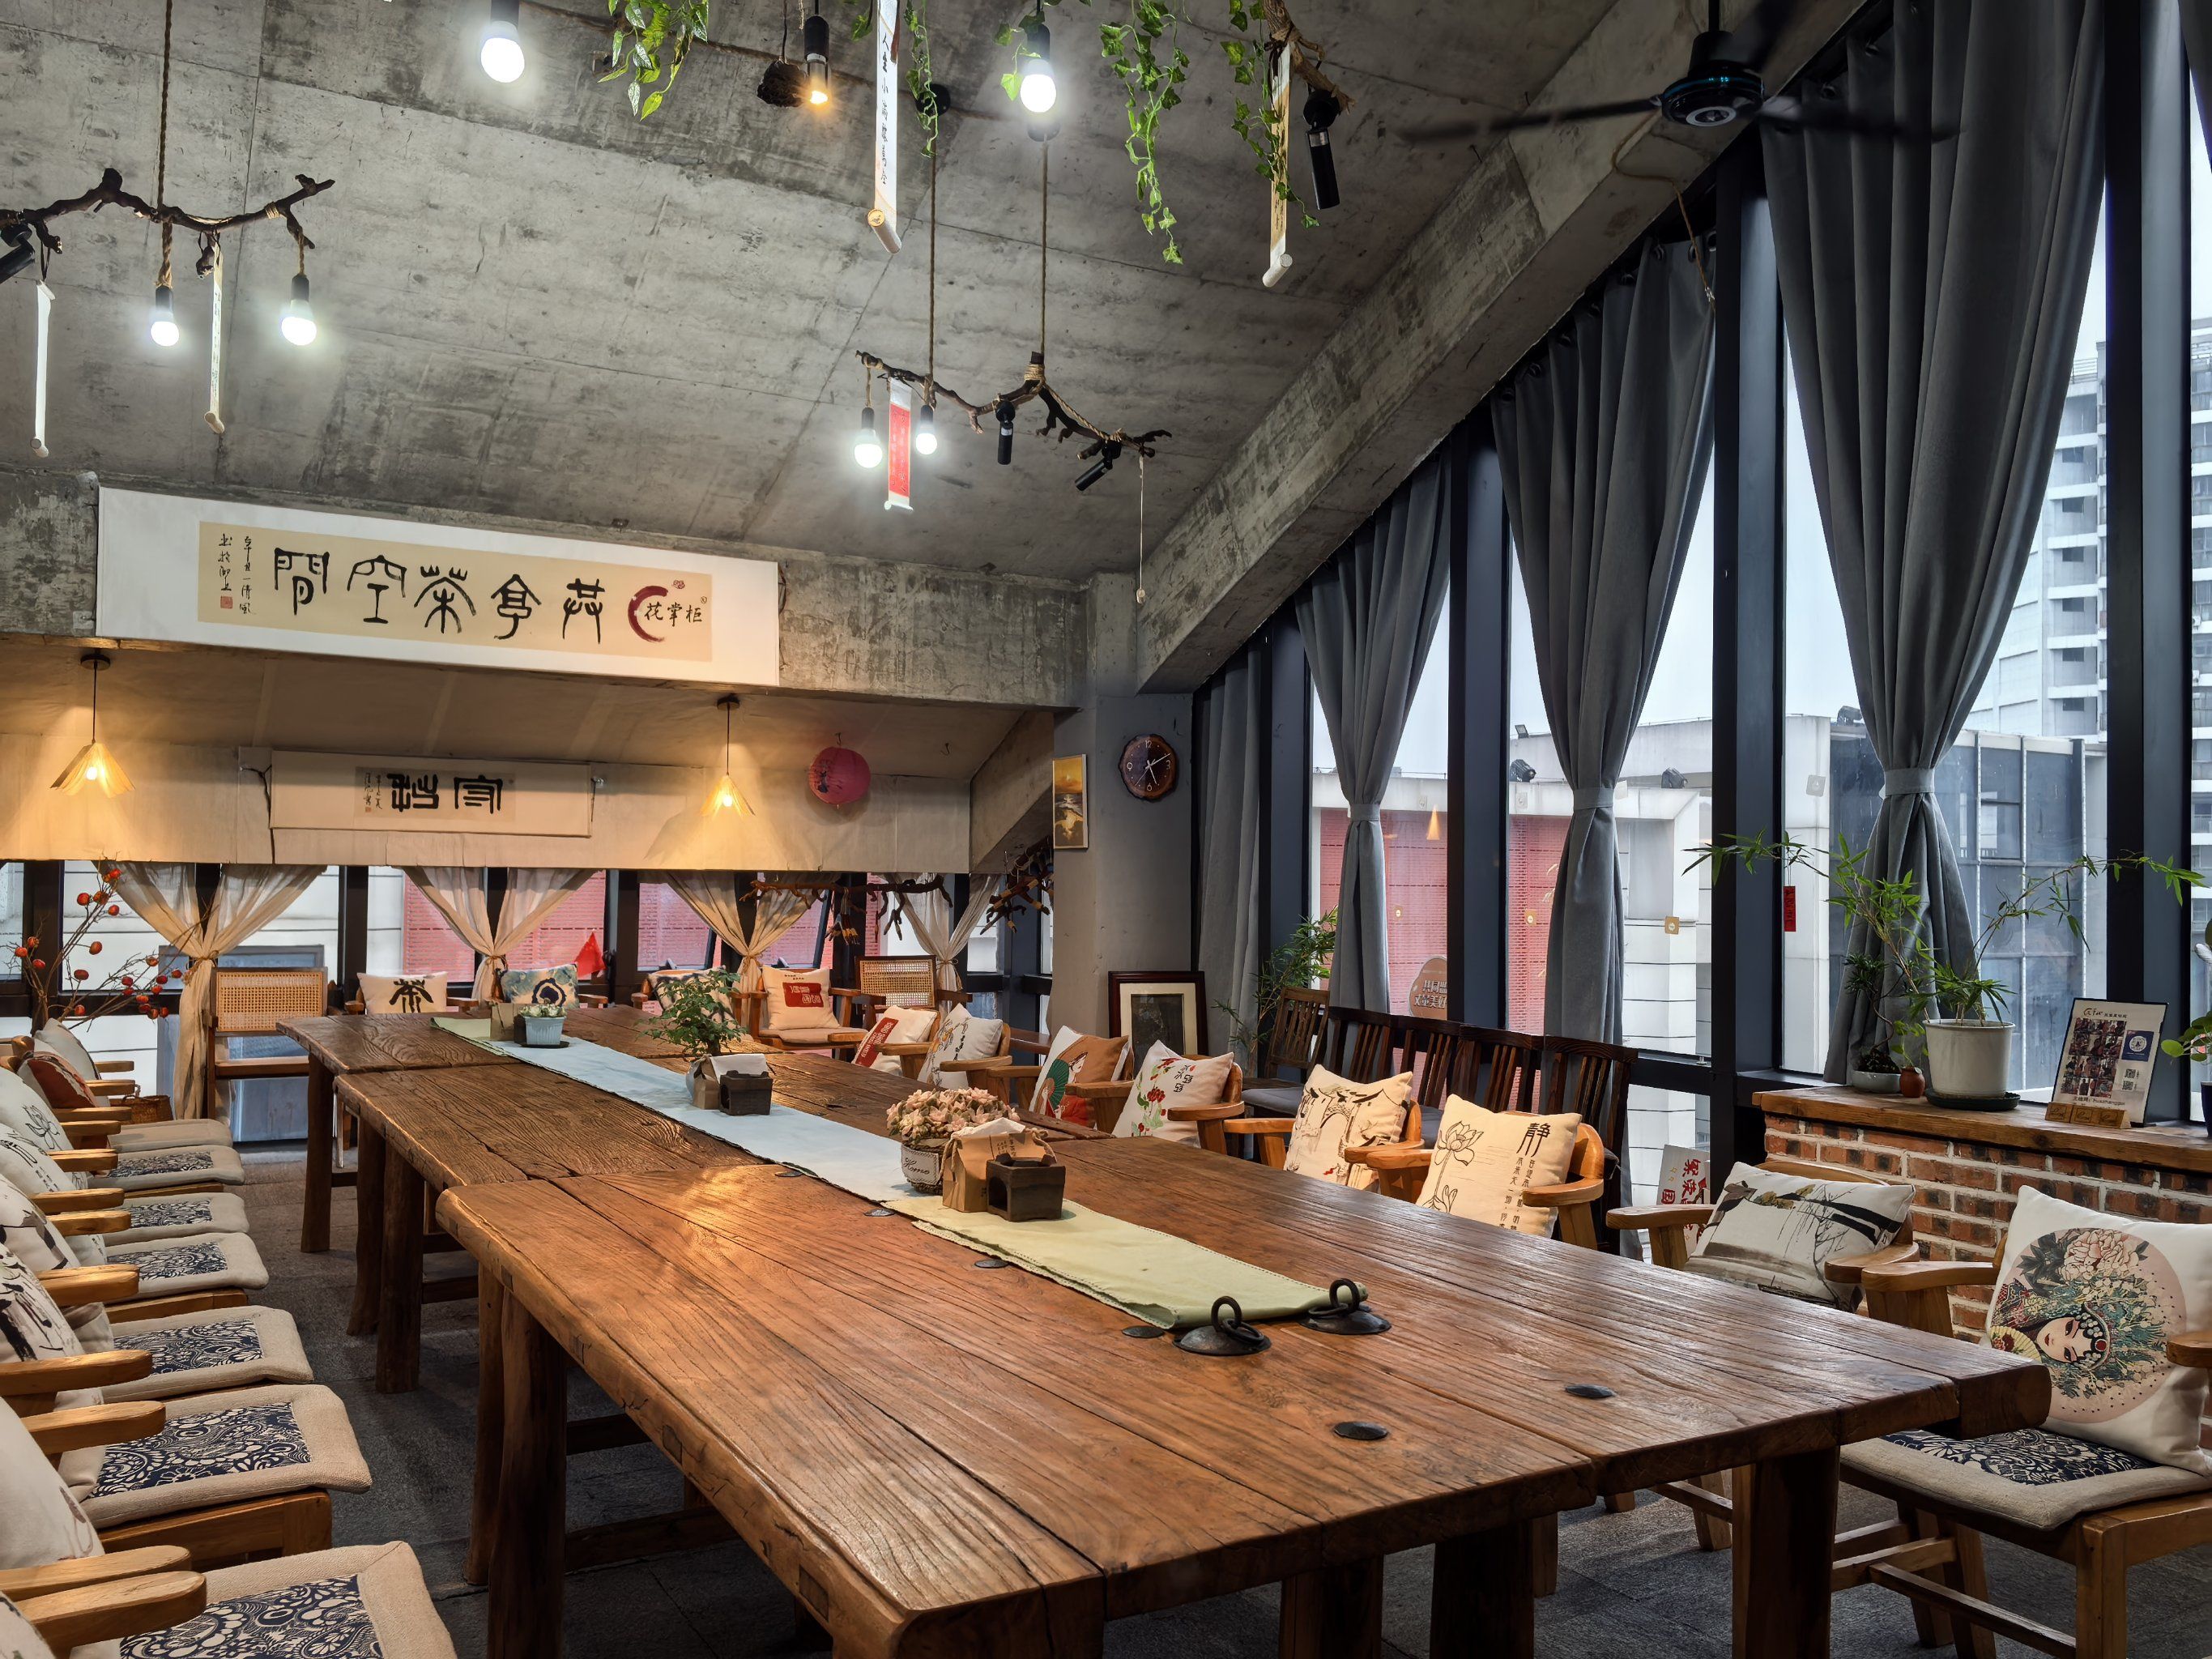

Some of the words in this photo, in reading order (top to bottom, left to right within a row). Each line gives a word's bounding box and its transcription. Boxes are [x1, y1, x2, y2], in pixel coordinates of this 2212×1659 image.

[644, 601, 703, 627] 花掌柜
[1145, 740, 1152, 748] 12
[1166, 760, 1171, 770] 3
[1147, 783, 1153, 791] 6
[1516, 1123, 1551, 1158] 静
